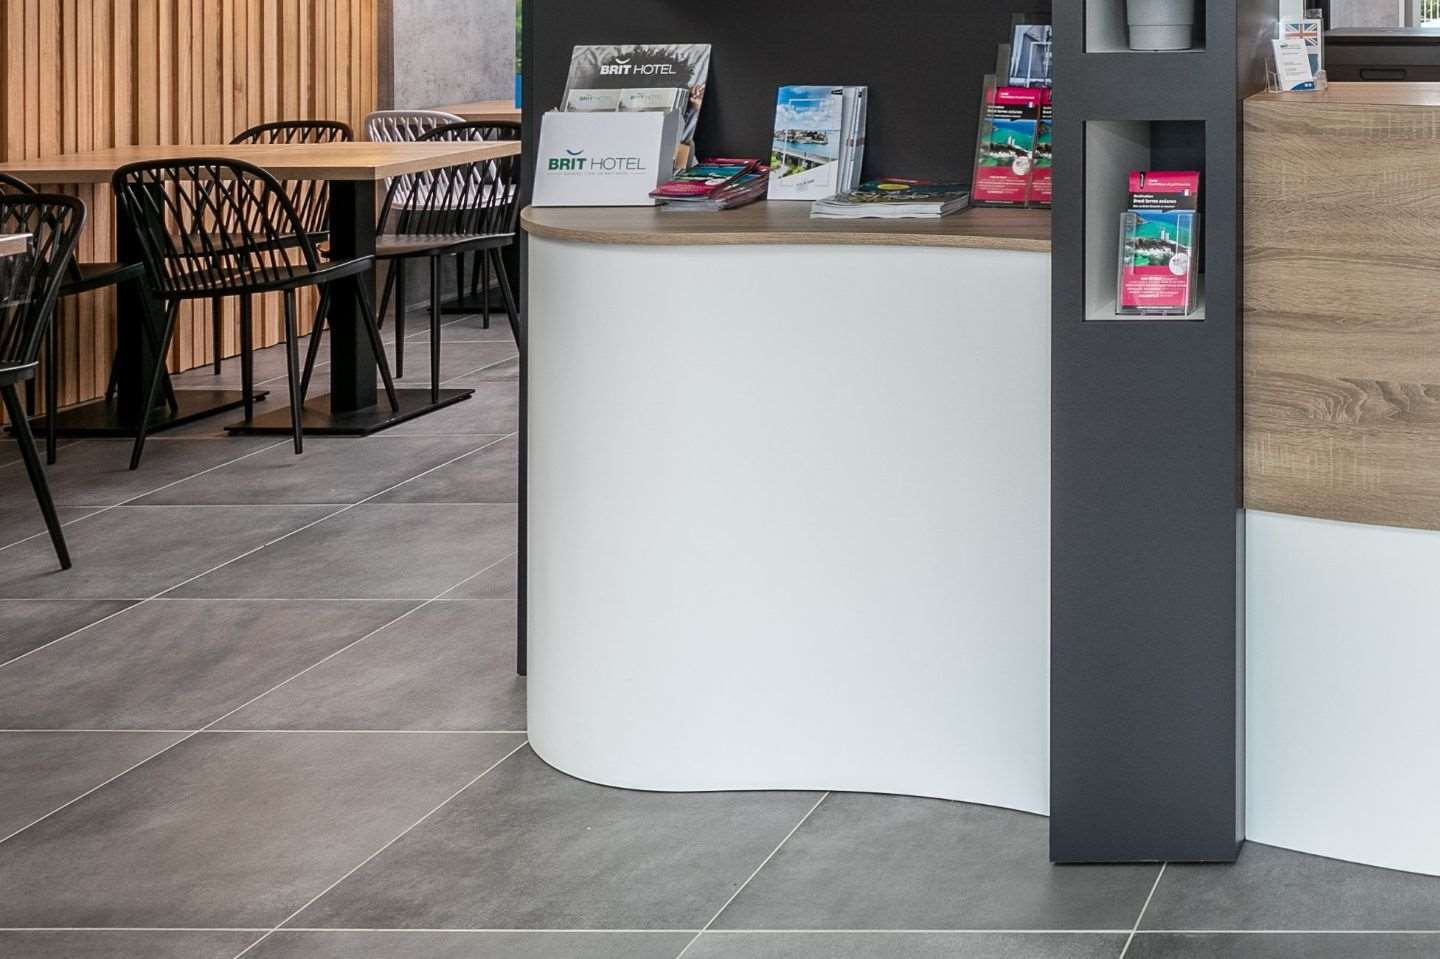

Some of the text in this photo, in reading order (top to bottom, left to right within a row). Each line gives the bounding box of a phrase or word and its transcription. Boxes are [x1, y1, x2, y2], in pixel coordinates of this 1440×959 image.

[600, 63, 677, 75] BRIT HOTEL
[548, 157, 647, 171] BRIT HOTEL
